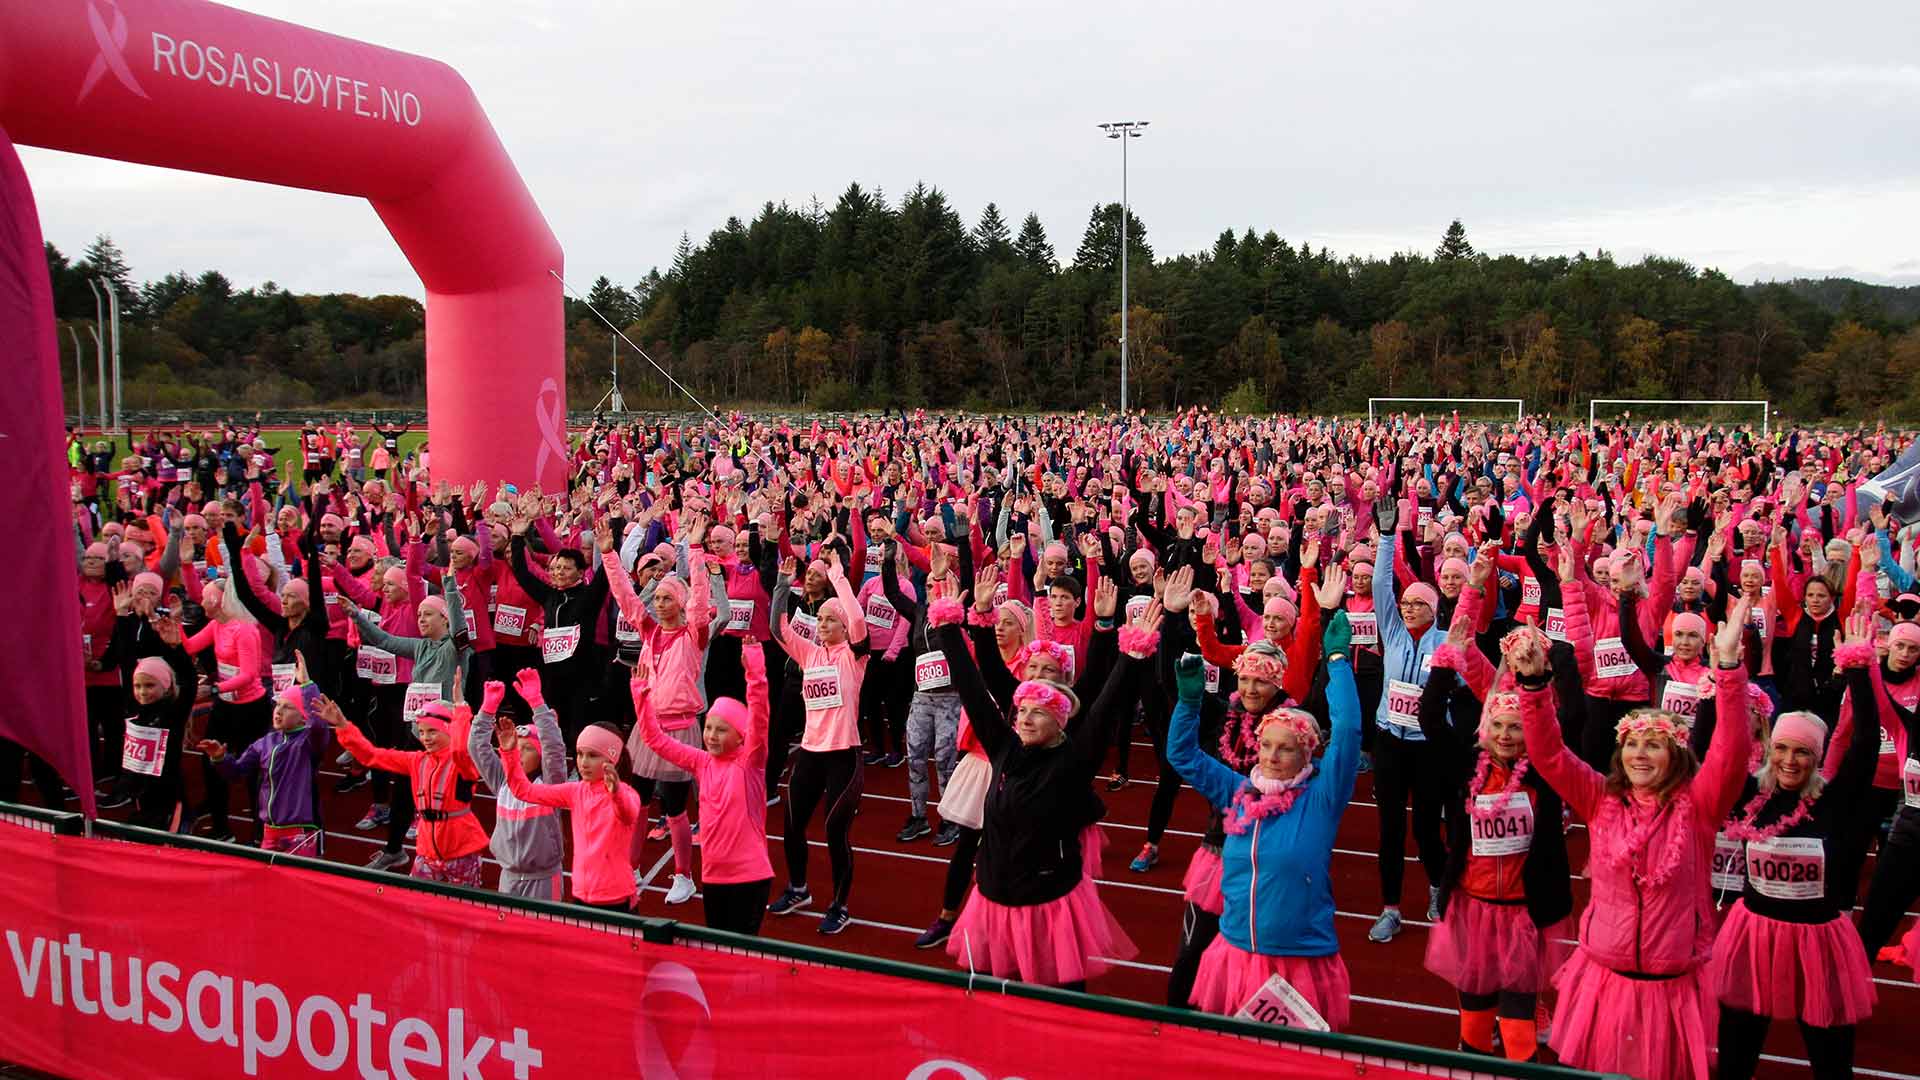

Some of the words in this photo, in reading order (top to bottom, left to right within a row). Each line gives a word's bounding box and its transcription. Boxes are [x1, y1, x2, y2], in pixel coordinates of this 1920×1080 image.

[151, 32, 421, 126] ROSASLØYFE.NO
[545, 639, 569, 653] 9263
[919, 665, 943, 680] 9308
[804, 681, 837, 699] 10065
[1475, 815, 1528, 839] 10041
[1752, 858, 1819, 882] 10028
